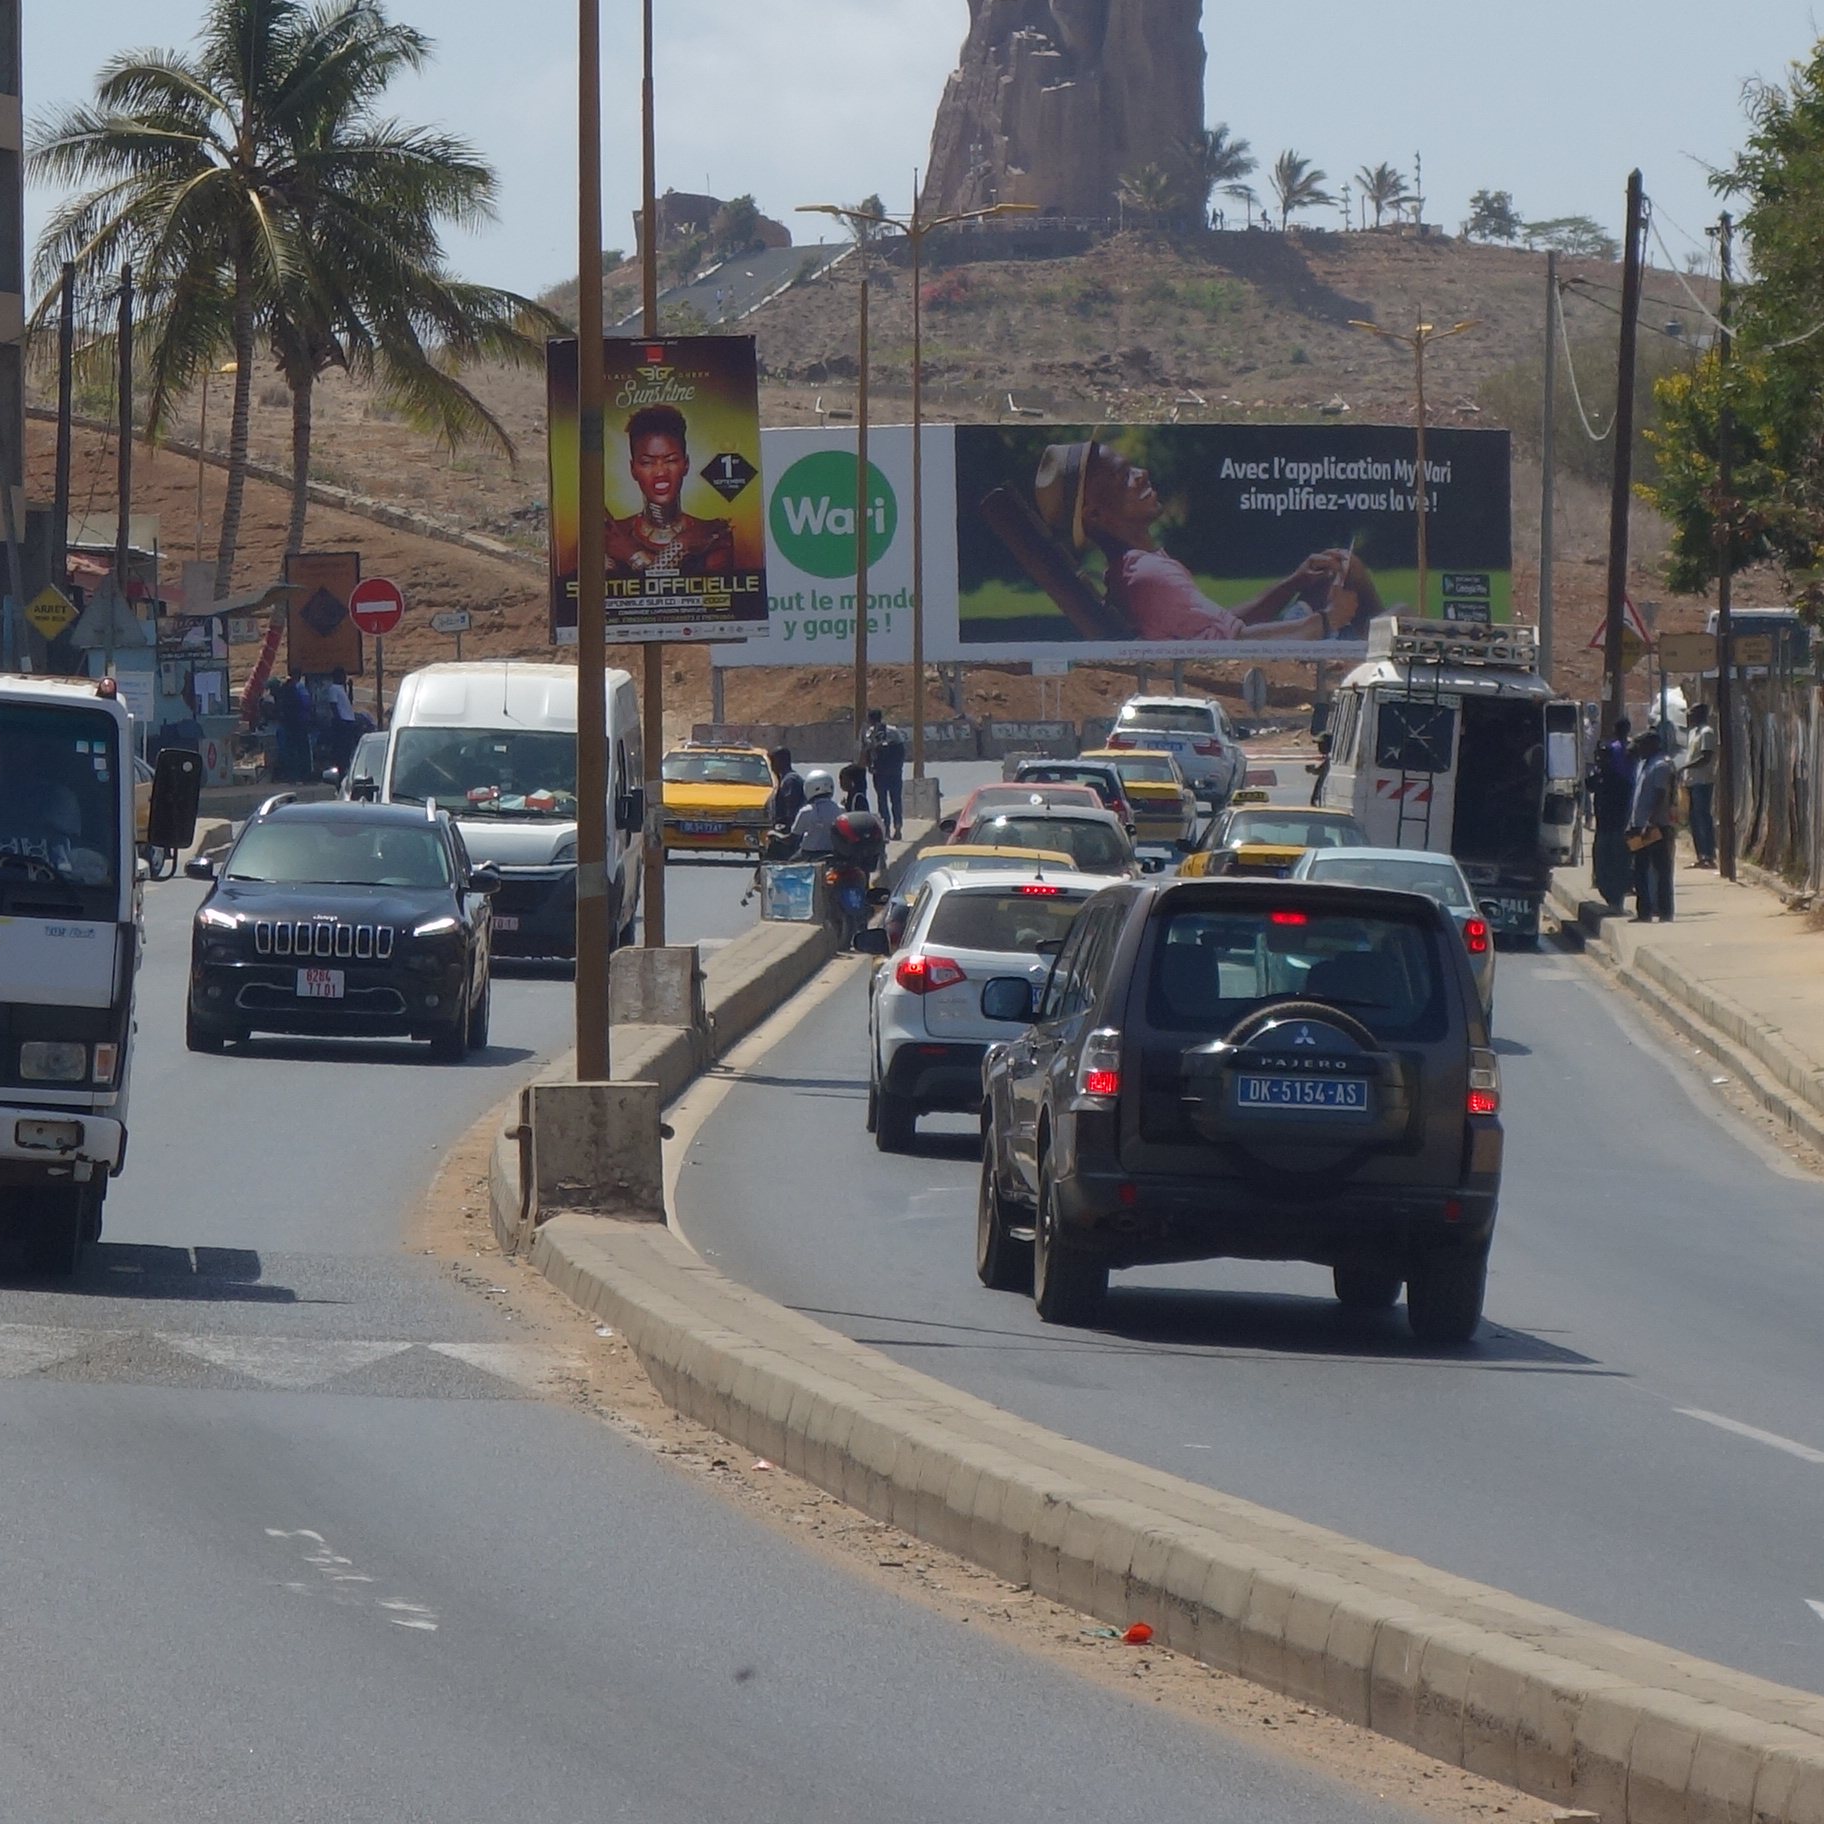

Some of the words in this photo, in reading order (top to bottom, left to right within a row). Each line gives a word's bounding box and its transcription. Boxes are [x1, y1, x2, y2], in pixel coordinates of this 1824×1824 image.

[616, 376, 696, 408] Sunshine
[1220, 458, 1270, 480] Avec
[1273, 457, 1391, 485] l'application
[1240, 488, 1387, 515] simplifiez-vous
[1390, 488, 1404, 511] la
[644, 575, 759, 595] OFFICIELLE
[767, 591, 805, 612] out
[811, 590, 833, 611] le
[783, 620, 797, 641] y
[885, 613, 892, 633] !
[1261, 1058, 1347, 1069] PAJERO
[1249, 1080, 1357, 1104] DK-5154-AS
